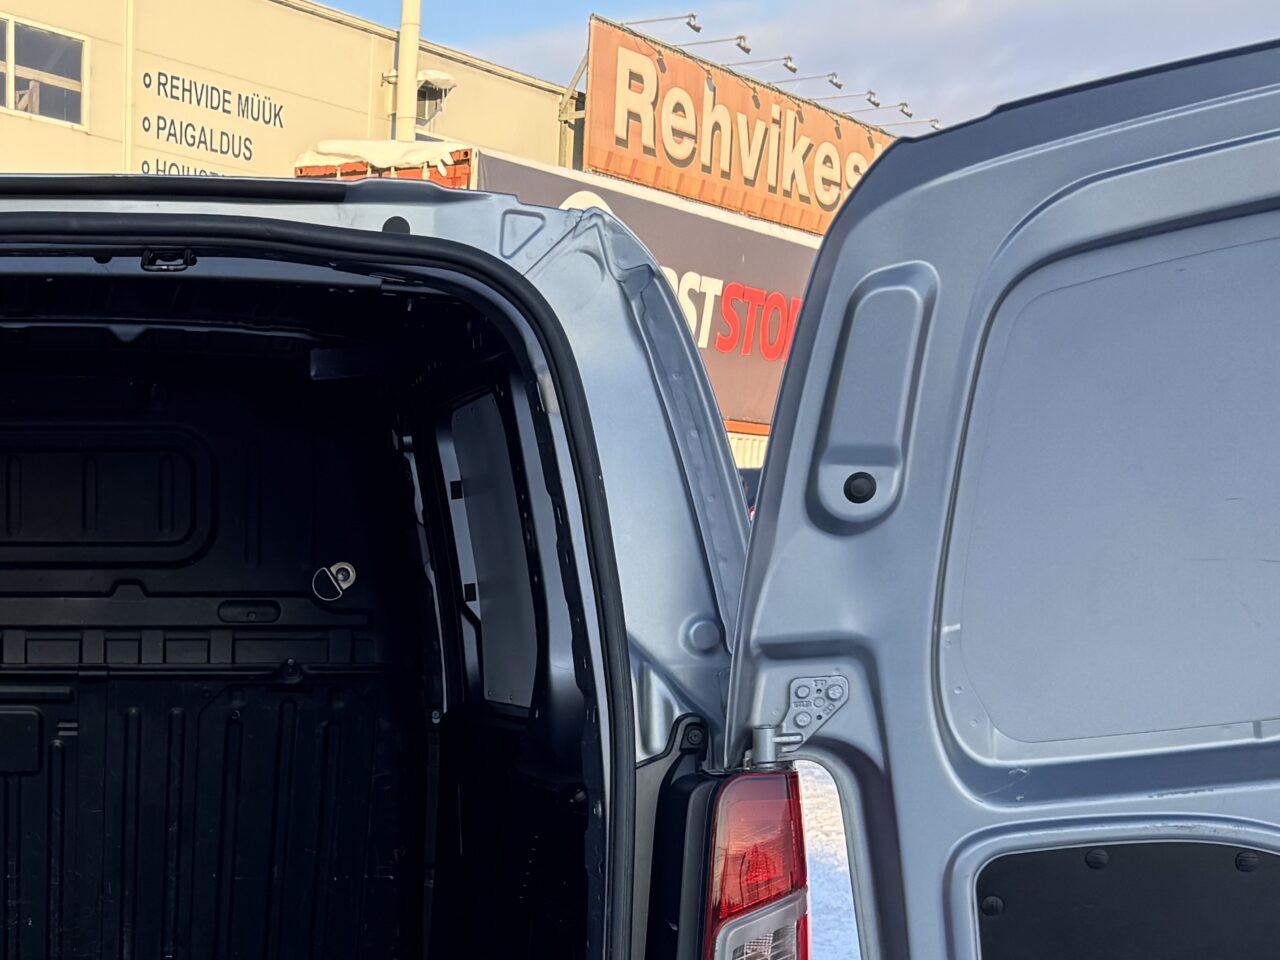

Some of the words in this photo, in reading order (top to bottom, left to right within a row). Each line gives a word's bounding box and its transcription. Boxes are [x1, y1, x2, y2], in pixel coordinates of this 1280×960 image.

[157, 72, 232, 114] REHVIDE
[237, 92, 284, 129] MÜÜK
[156, 115, 253, 161] PAIGALDUS
